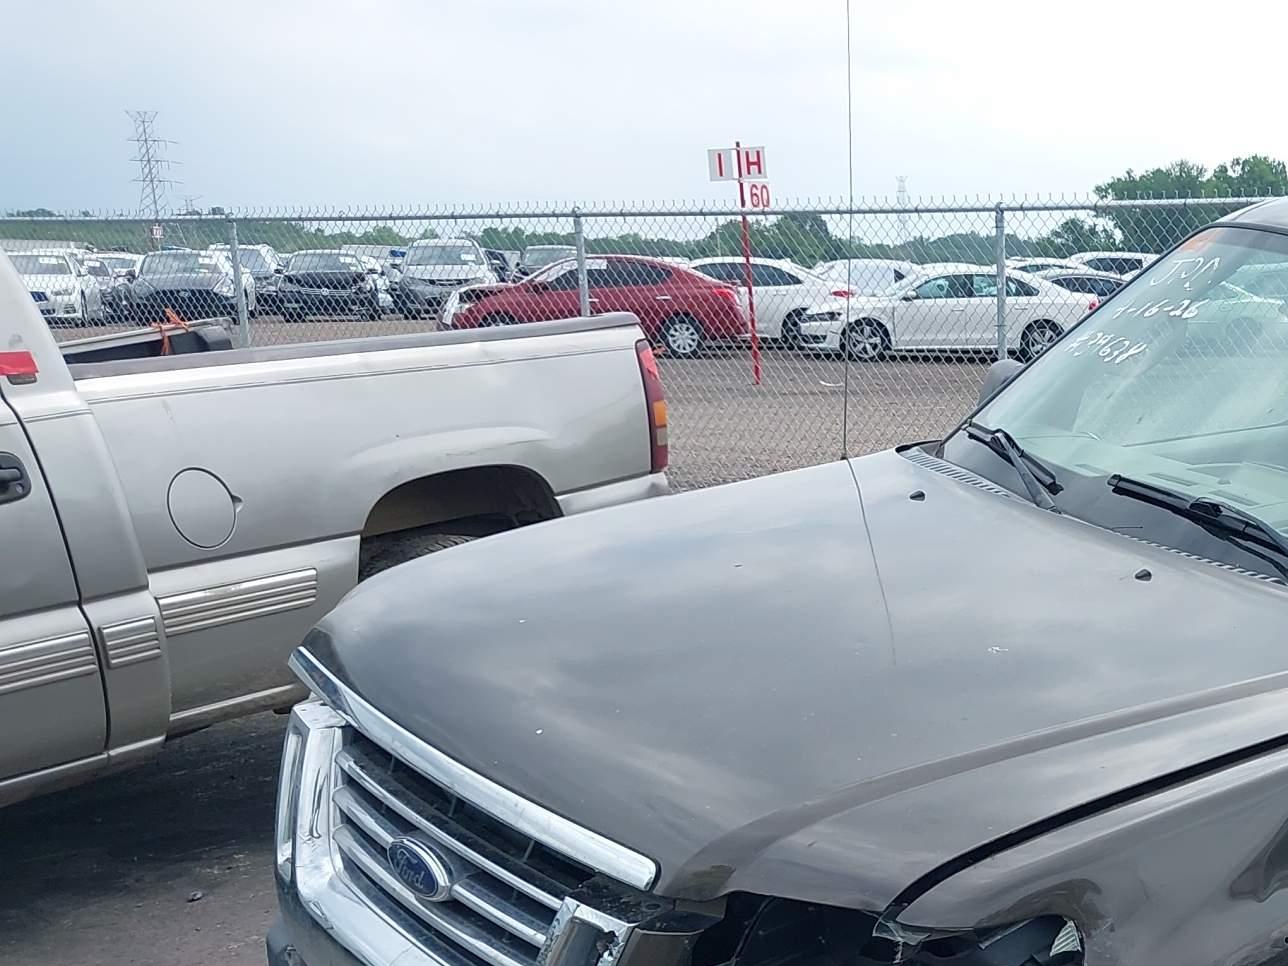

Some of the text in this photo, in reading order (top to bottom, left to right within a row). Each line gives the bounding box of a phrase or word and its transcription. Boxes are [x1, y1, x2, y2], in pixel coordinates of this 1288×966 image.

[744, 150, 763, 175] H
[750, 183, 770, 208] 60
[392, 848, 426, 889] Ford
